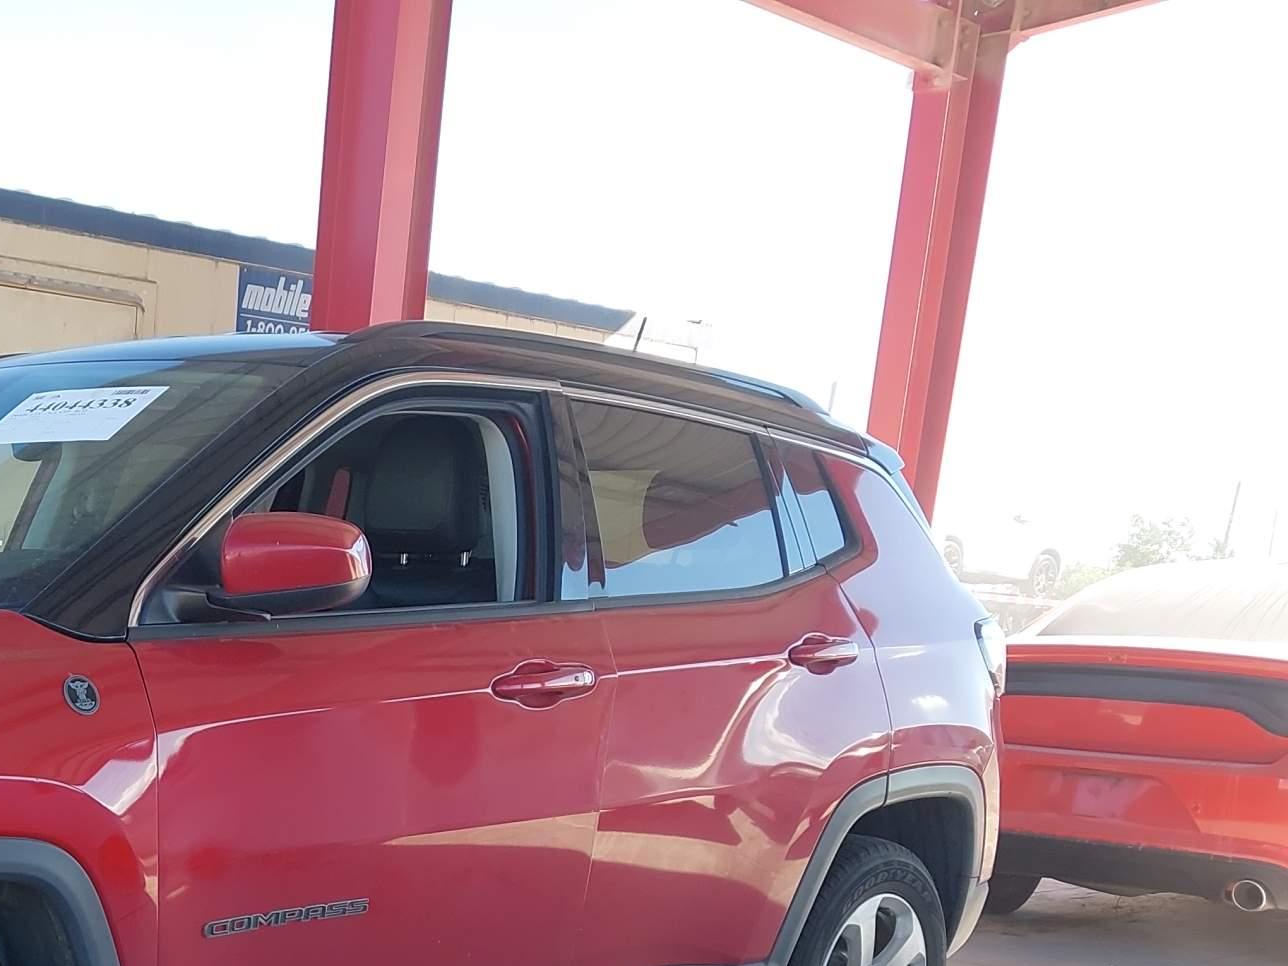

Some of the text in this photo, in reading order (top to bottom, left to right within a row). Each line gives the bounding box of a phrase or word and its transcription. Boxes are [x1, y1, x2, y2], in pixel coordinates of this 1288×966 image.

[241, 276, 312, 318] mobile
[25, 397, 137, 413] 44044338
[202, 898, 369, 939] COMPASS
